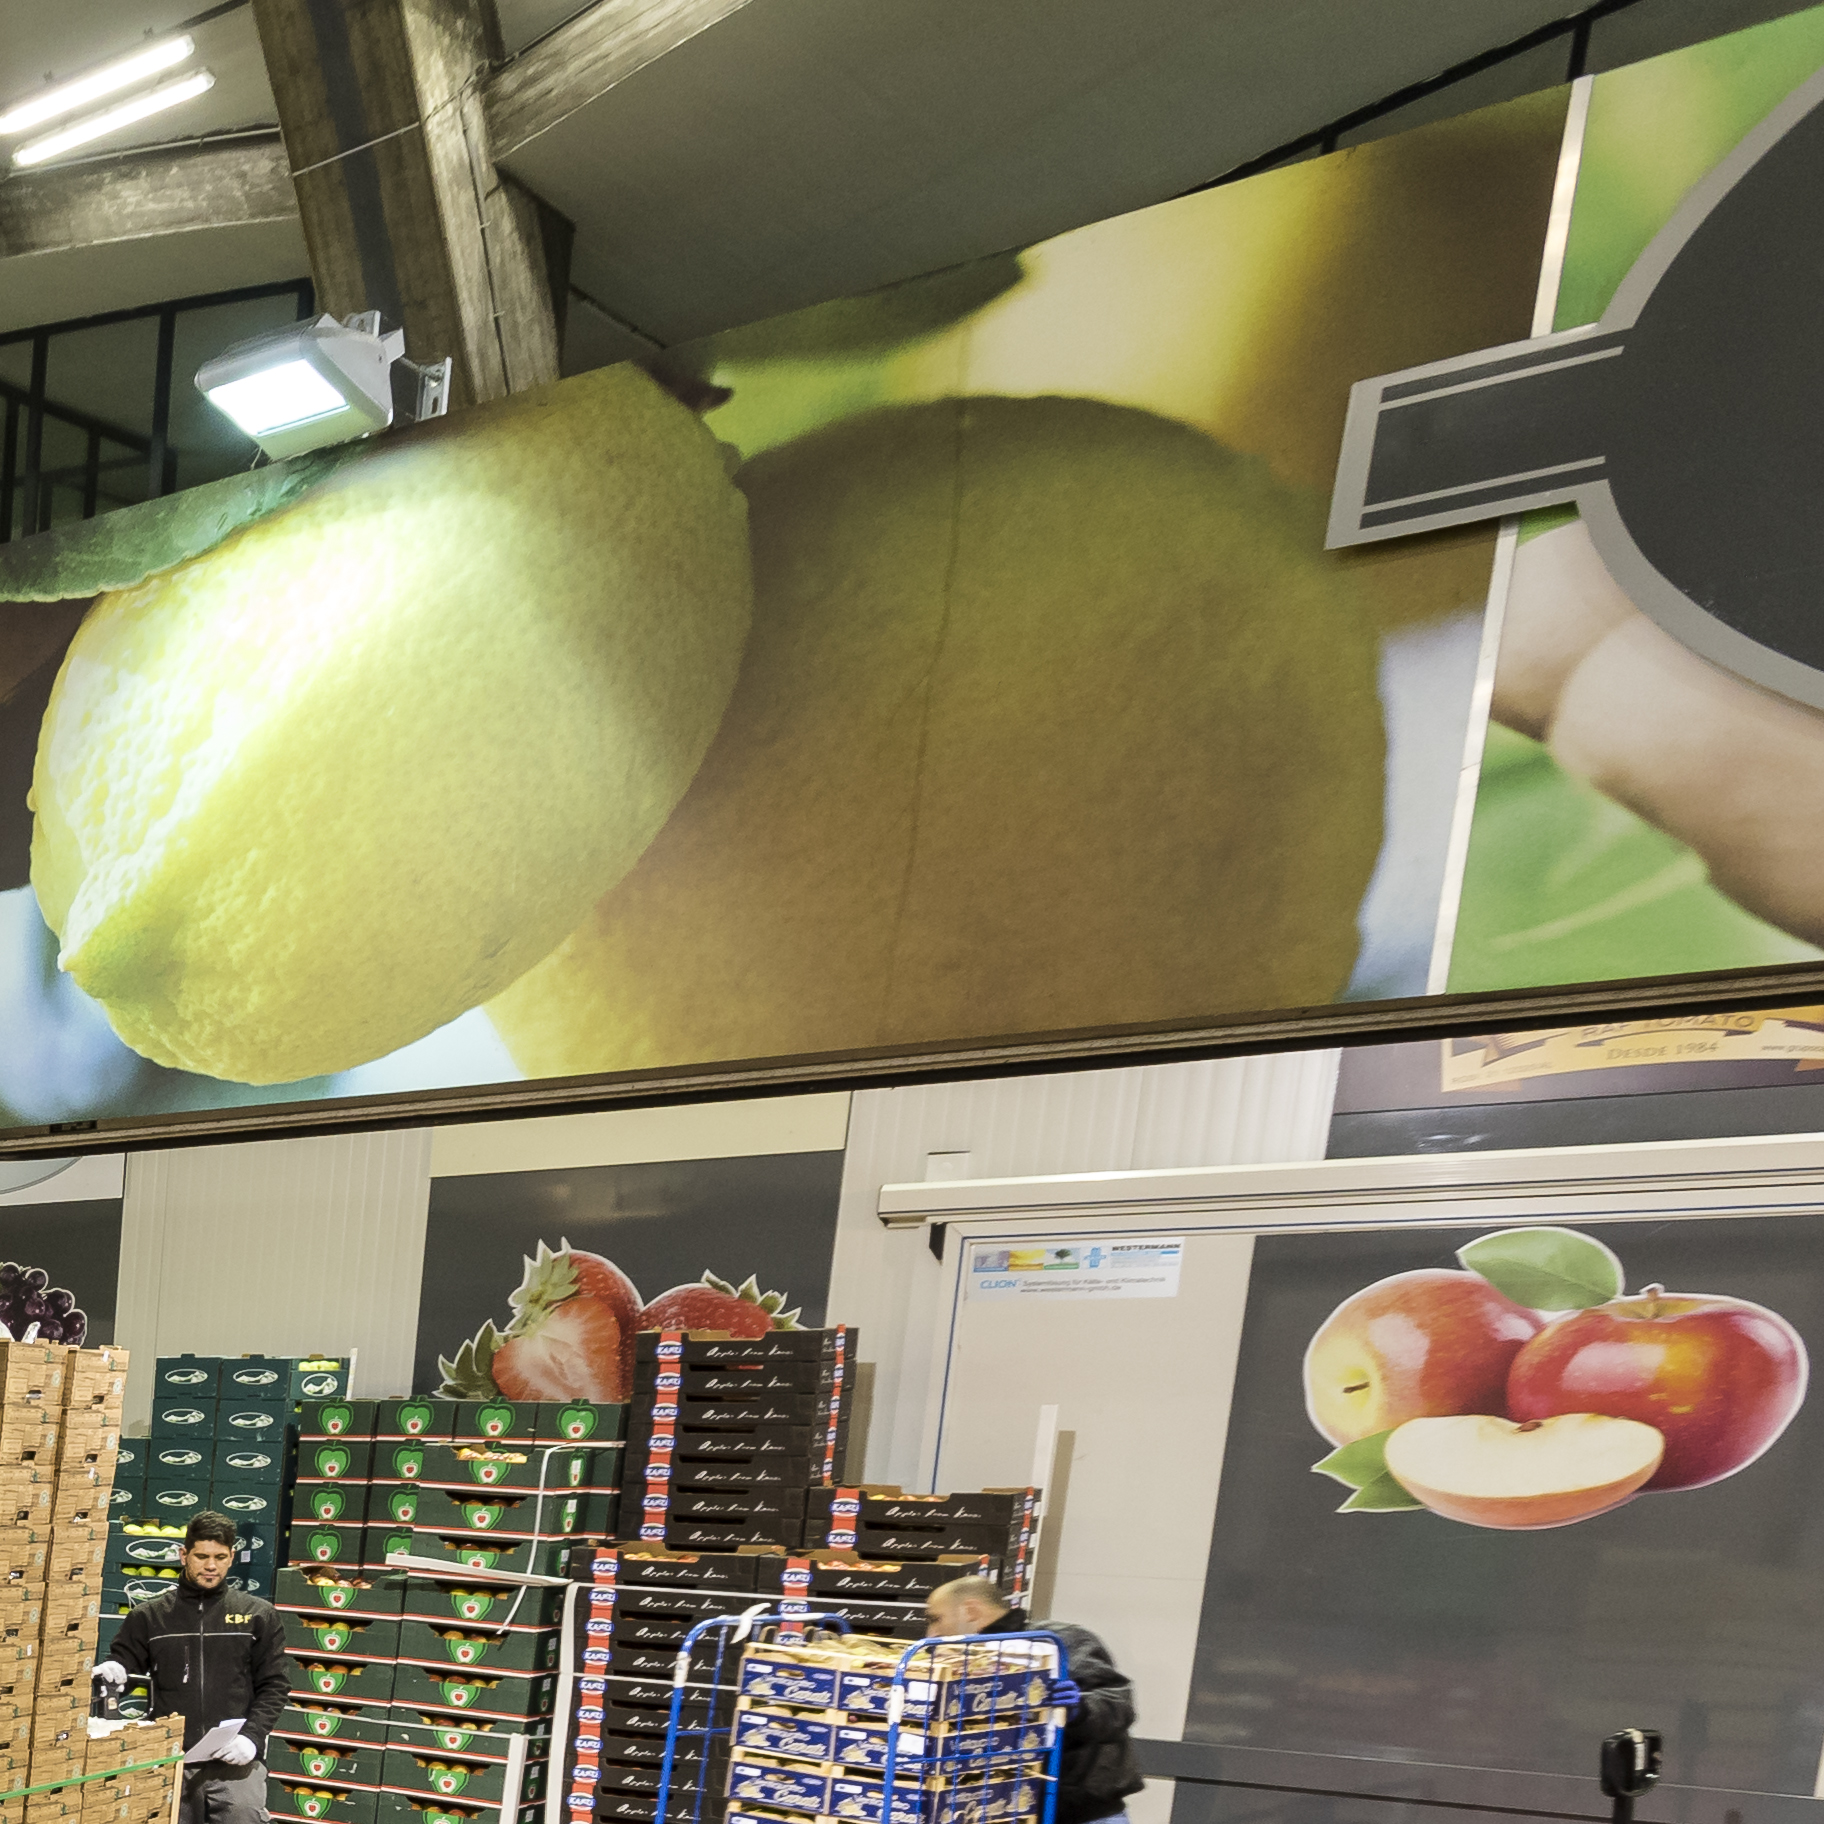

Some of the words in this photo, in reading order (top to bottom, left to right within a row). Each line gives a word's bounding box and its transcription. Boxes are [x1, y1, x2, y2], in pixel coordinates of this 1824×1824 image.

[1606, 1044, 1667, 1060] DESDE
[1676, 1041, 1719, 1055] 1984
[225, 1614, 252, 1624] KBF
